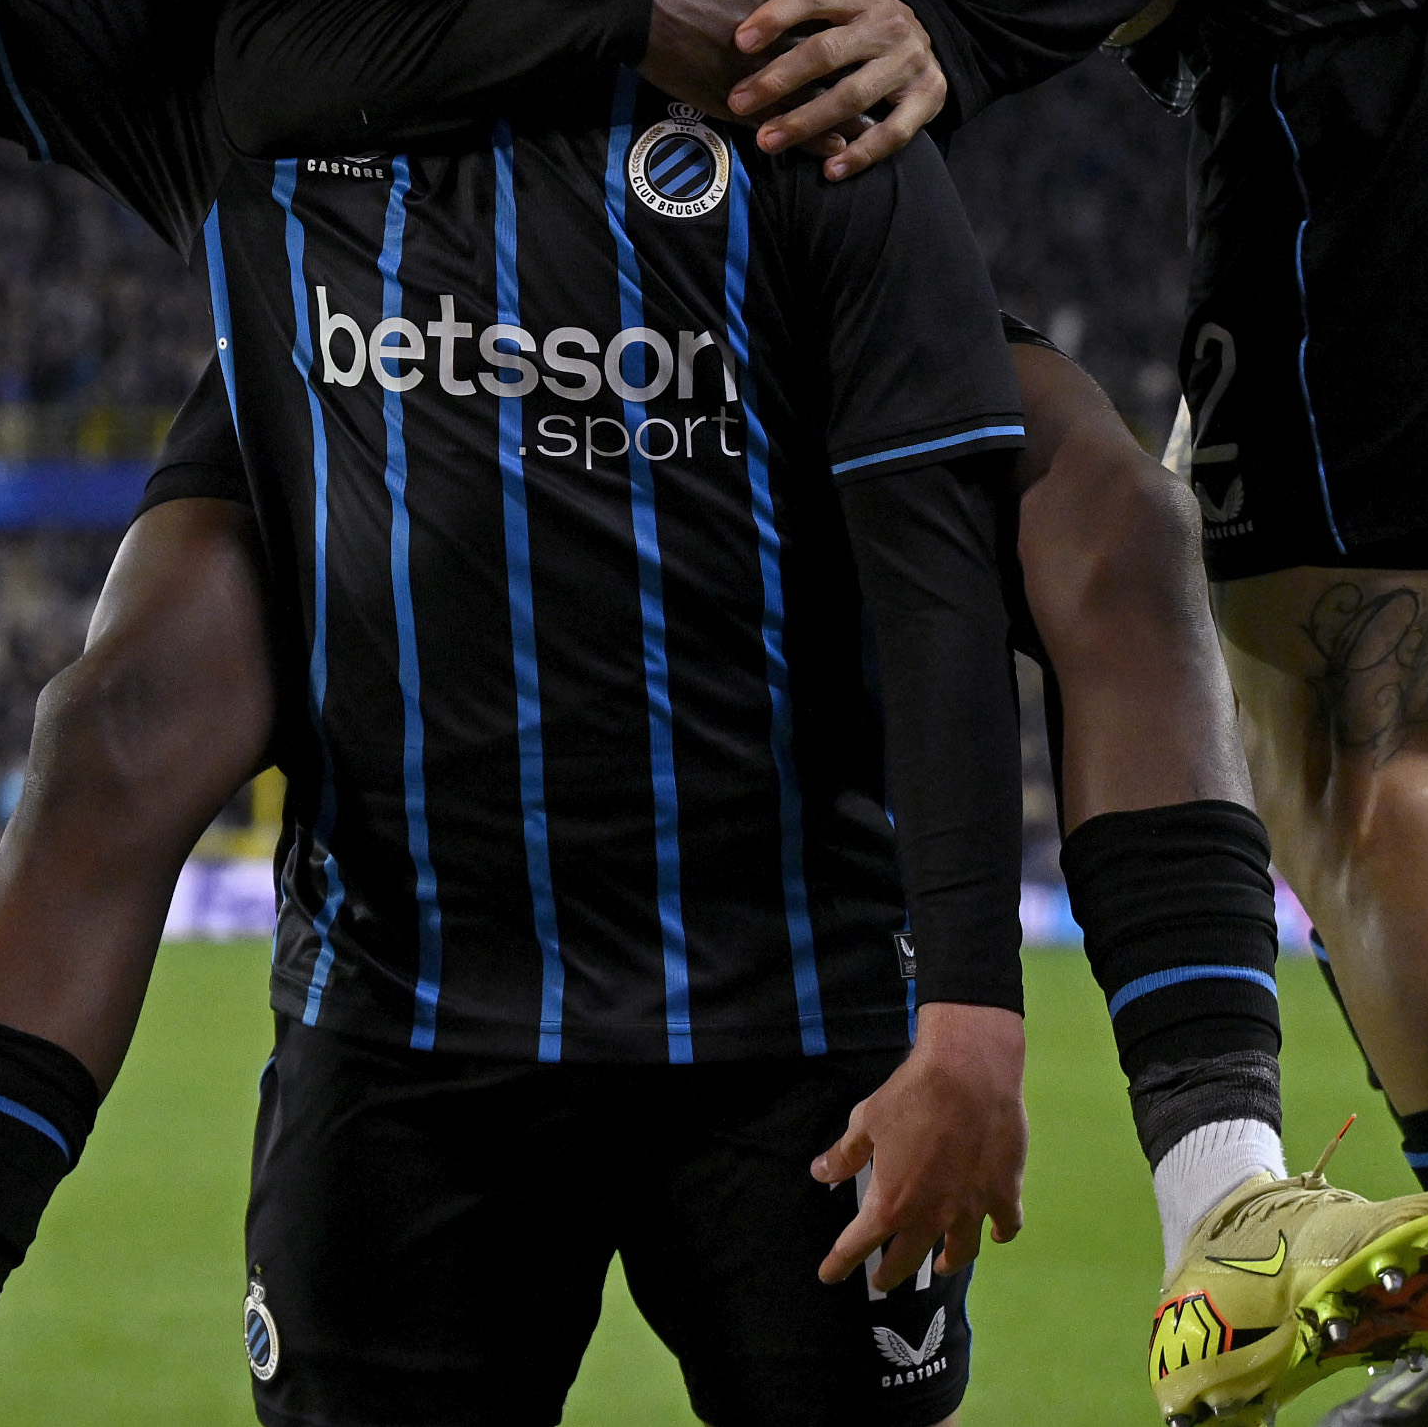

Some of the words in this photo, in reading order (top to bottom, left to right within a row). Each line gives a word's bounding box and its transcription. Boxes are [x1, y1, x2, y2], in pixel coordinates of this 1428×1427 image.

[306, 158, 385, 179] CASTORE
[632, 175, 657, 205] CLUB
[657, 199, 710, 216] BRUGGE
[708, 184, 724, 203] KV
[316, 285, 739, 403] betsson
[881, 1356, 948, 1388] CASTORE
